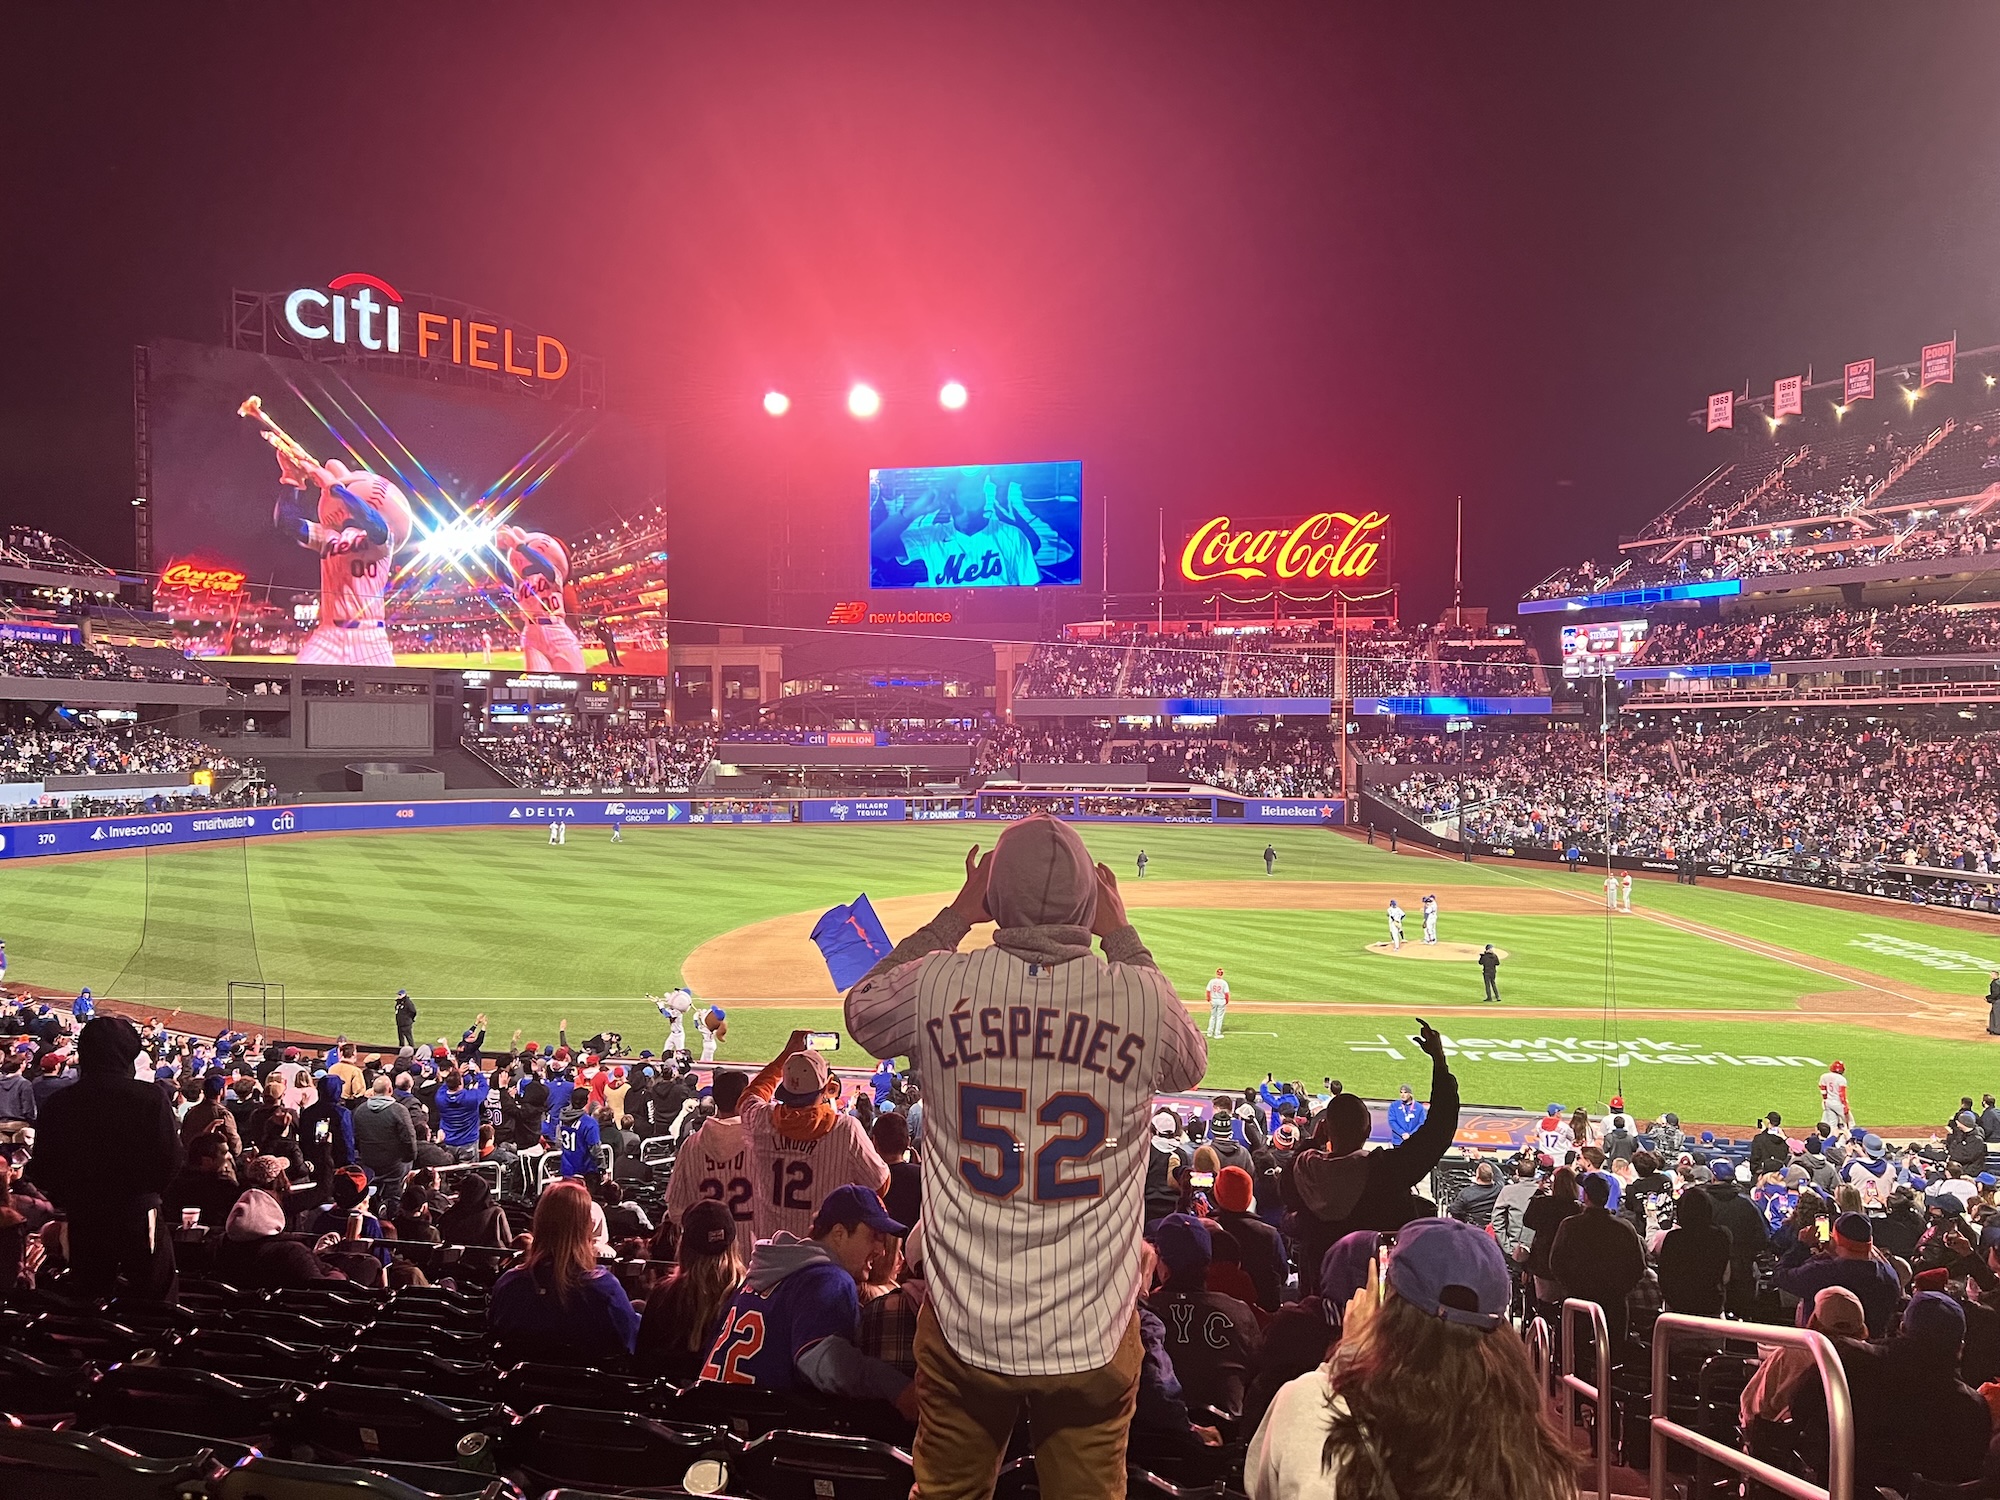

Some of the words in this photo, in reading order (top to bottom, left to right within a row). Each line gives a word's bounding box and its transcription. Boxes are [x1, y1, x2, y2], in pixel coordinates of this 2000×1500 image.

[285, 287, 400, 354] citi
[418, 312, 570, 381] FIELD
[1925, 345, 1950, 360] 2000
[1779, 380, 1797, 391] 1986
[1712, 395, 1729, 406] 1969
[1181, 511, 1391, 581] Coca-Cola
[935, 550, 1003, 585] Mets
[869, 612, 897, 624] new
[897, 610, 952, 624] balance
[16, 630, 41, 640] PORCH
[41, 633, 58, 642] BAR
[808, 734, 825, 744] citi
[830, 736, 872, 744] PAVILION
[525, 807, 575, 817] DELTA
[625, 808, 666, 816] HAUGLAND
[856, 809, 888, 817] TEQUILA
[964, 811, 977, 819] 370
[1261, 805, 1317, 817] Heineken
[192, 816, 248, 832] smartwater
[271, 815, 294, 831] citi
[688, 814, 705, 823] 380
[1164, 816, 1214, 824] CADILLAC
[109, 825, 150, 838] Invesco
[151, 821, 173, 835] QQQ
[37, 833, 56, 845] 370
[926, 997, 1145, 1084] CÉSPEDES
[1213, 1118, 1232, 1127] JETS
[561, 1130, 576, 1152] 31
[957, 1081, 1109, 1204] 52
[1545, 1134, 1558, 1148] 17
[771, 1157, 815, 1210] 12
[699, 1177, 754, 1221] 22
[1169, 1303, 1234, 1349] YC
[699, 1305, 766, 1384] 22
